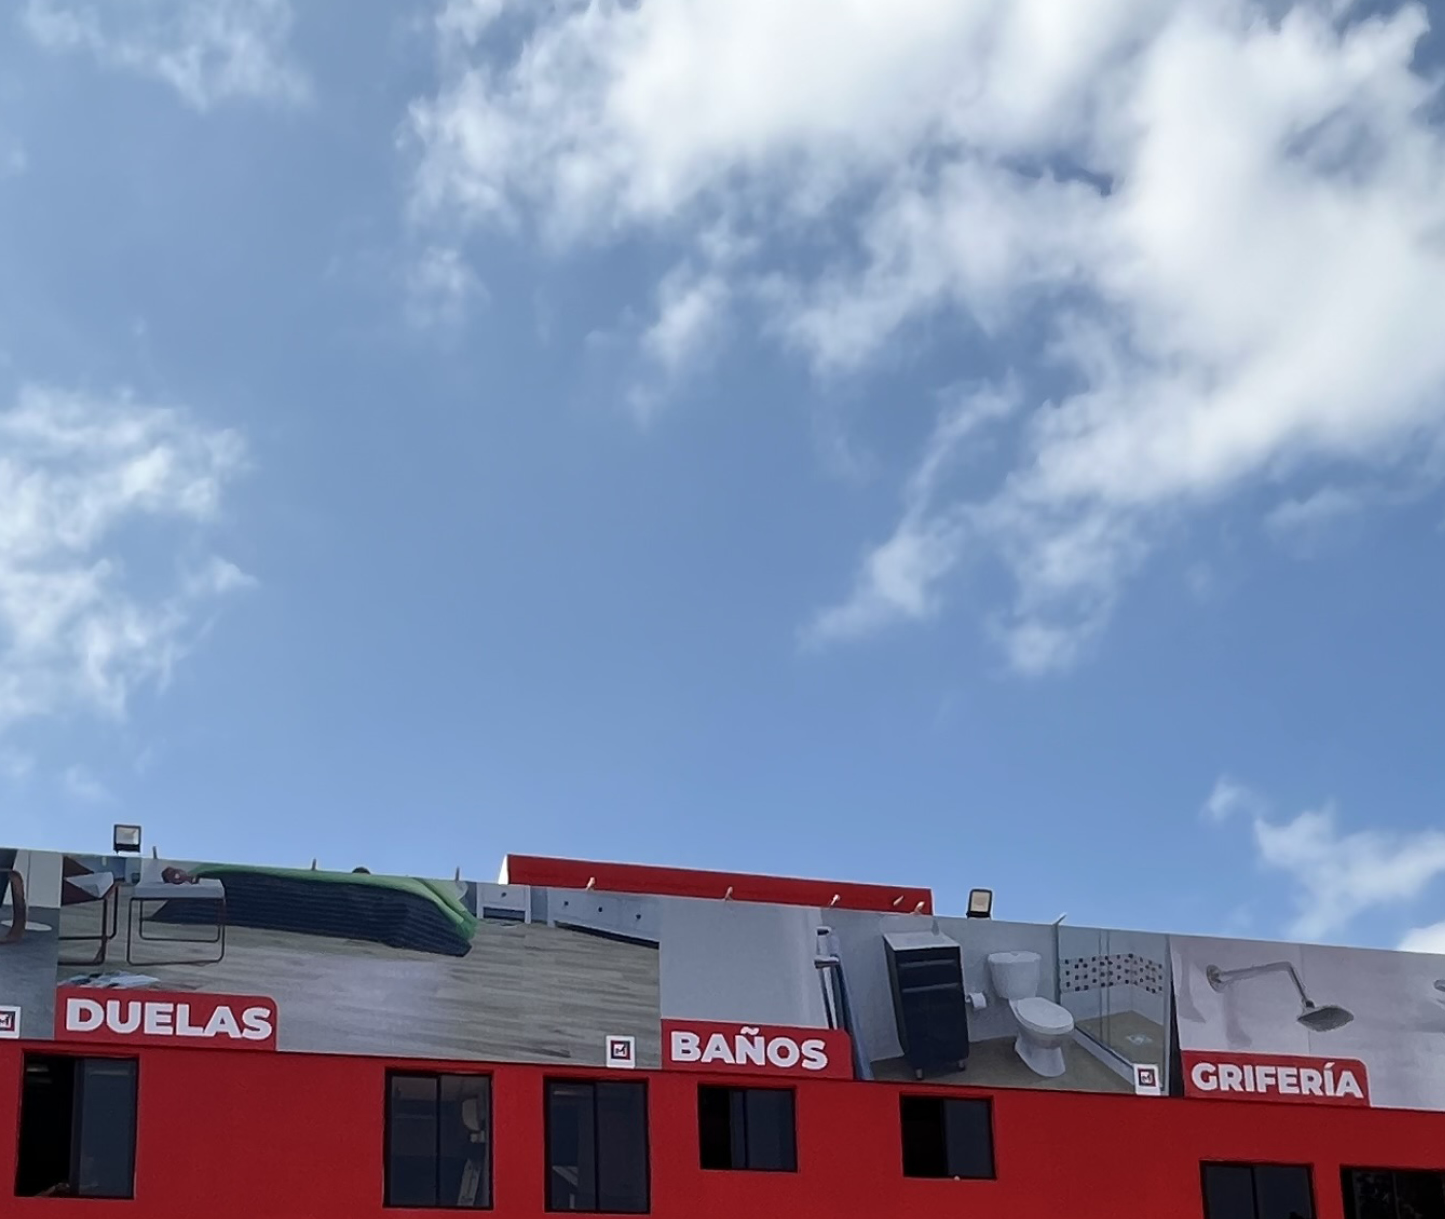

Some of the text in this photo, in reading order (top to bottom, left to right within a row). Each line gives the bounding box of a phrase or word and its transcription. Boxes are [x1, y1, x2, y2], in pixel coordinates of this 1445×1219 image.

[65, 998, 274, 1042] DUELAS
[670, 1027, 828, 1071] BAÑOS
[1191, 1061, 1364, 1099] GRIFERÍA
